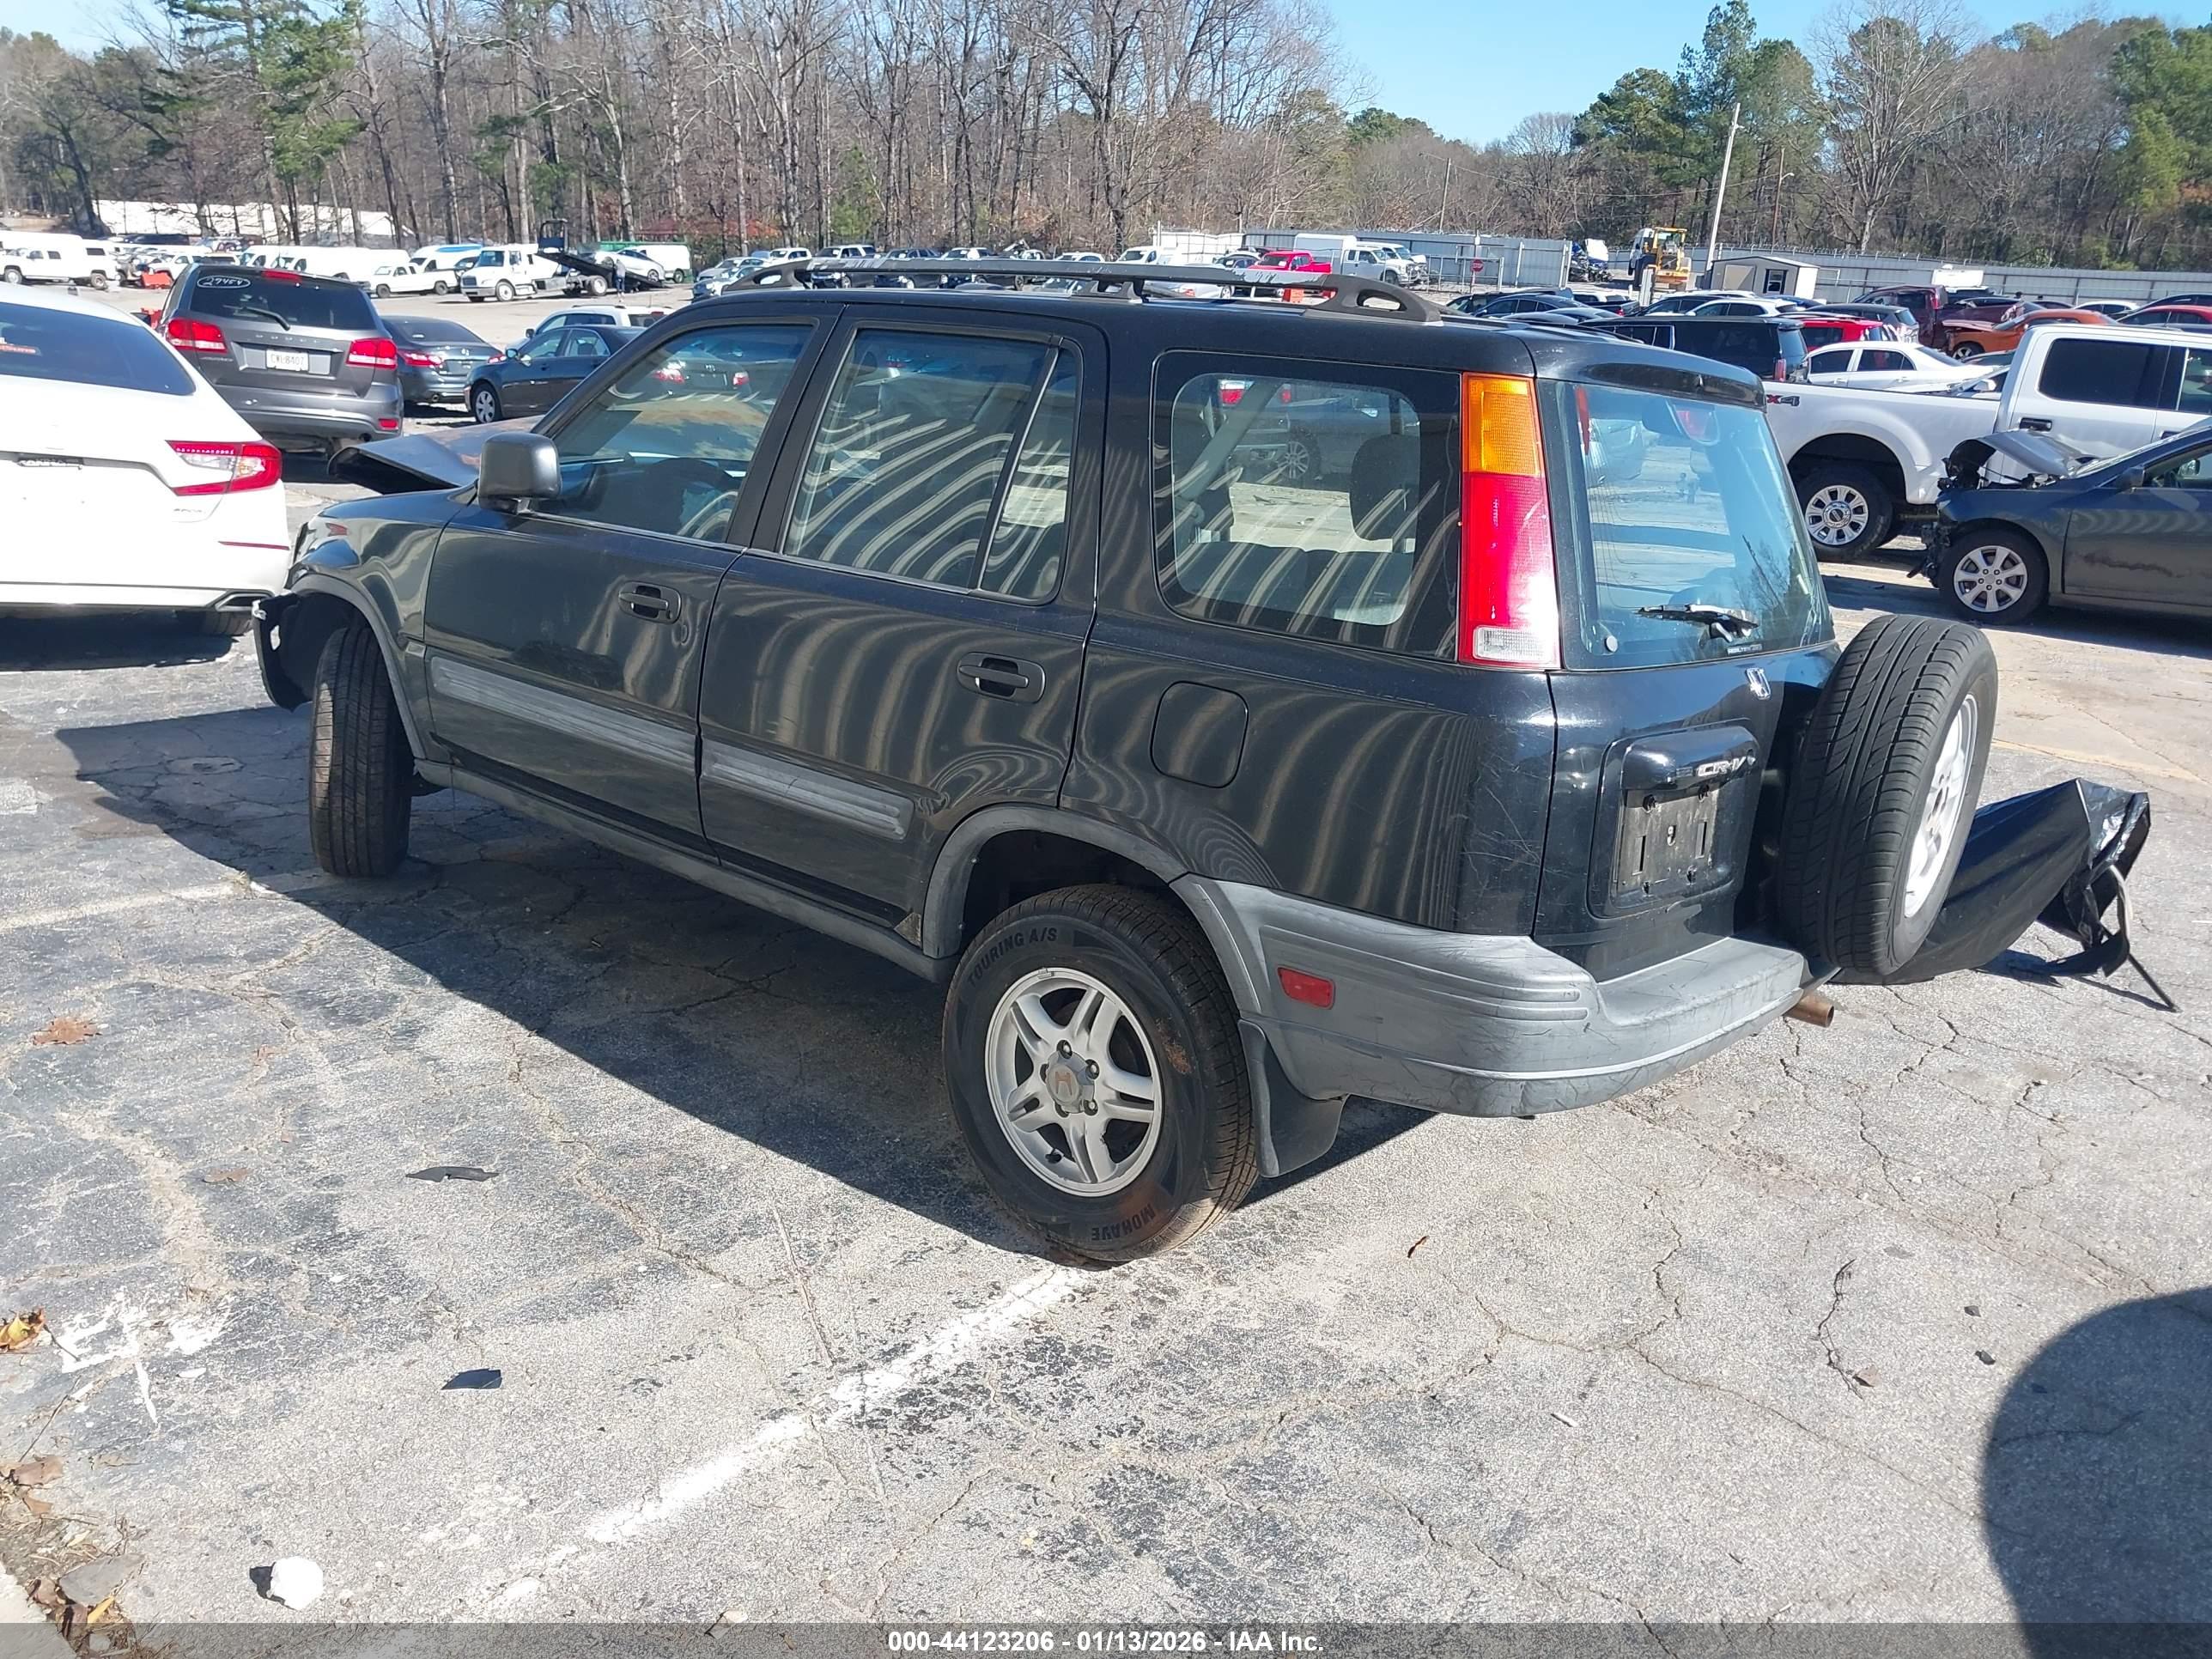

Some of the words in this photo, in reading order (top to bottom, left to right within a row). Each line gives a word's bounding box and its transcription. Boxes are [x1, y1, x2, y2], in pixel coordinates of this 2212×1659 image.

[1766, 394, 1800, 407] X4
[1697, 756, 1747, 777] CR-V
[967, 932, 1024, 987] TOURING
[1030, 927, 1058, 943] A/S
[1091, 1203, 1157, 1242] MOHAVE
